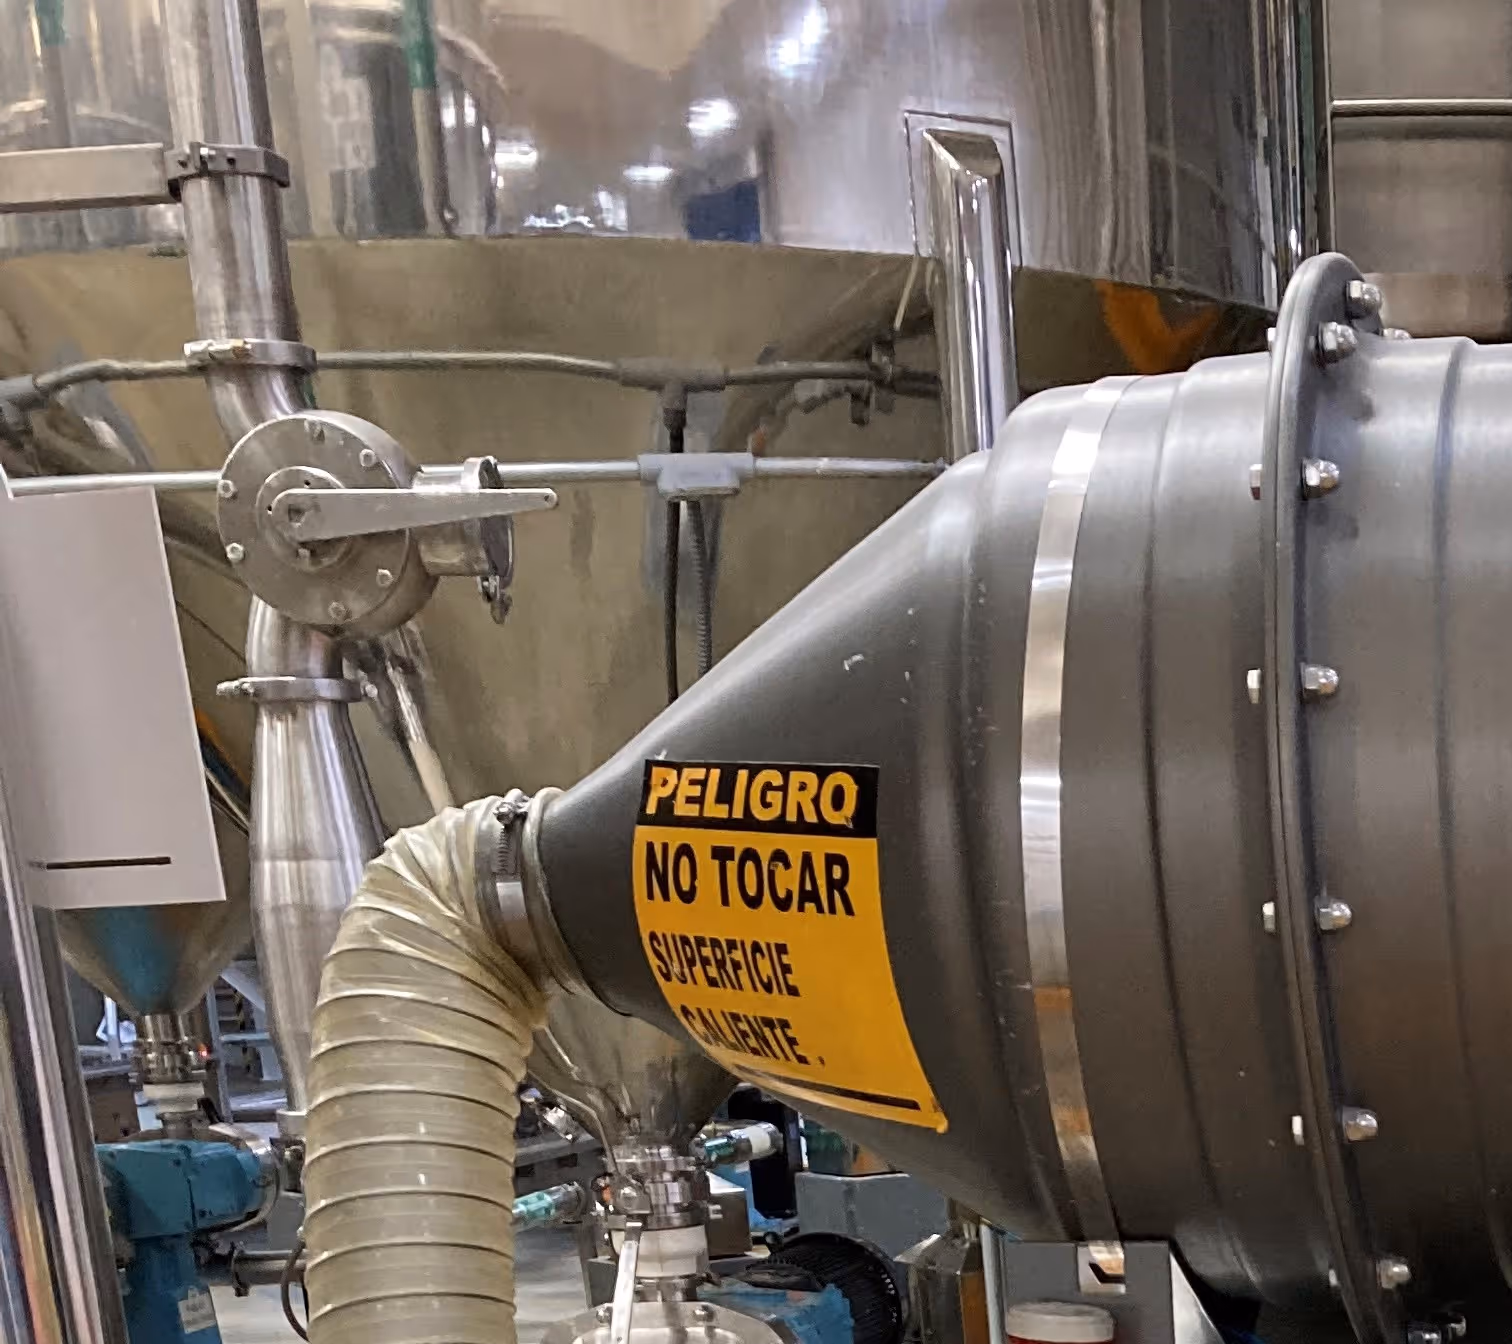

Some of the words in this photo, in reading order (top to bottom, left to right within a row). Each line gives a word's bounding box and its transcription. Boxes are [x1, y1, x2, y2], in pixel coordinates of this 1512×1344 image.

[645, 767, 858, 826] PELIGRO
[645, 840, 698, 905] NO
[711, 845, 855, 917] TOCAR
[648, 930, 801, 998] SUPERFICIE
